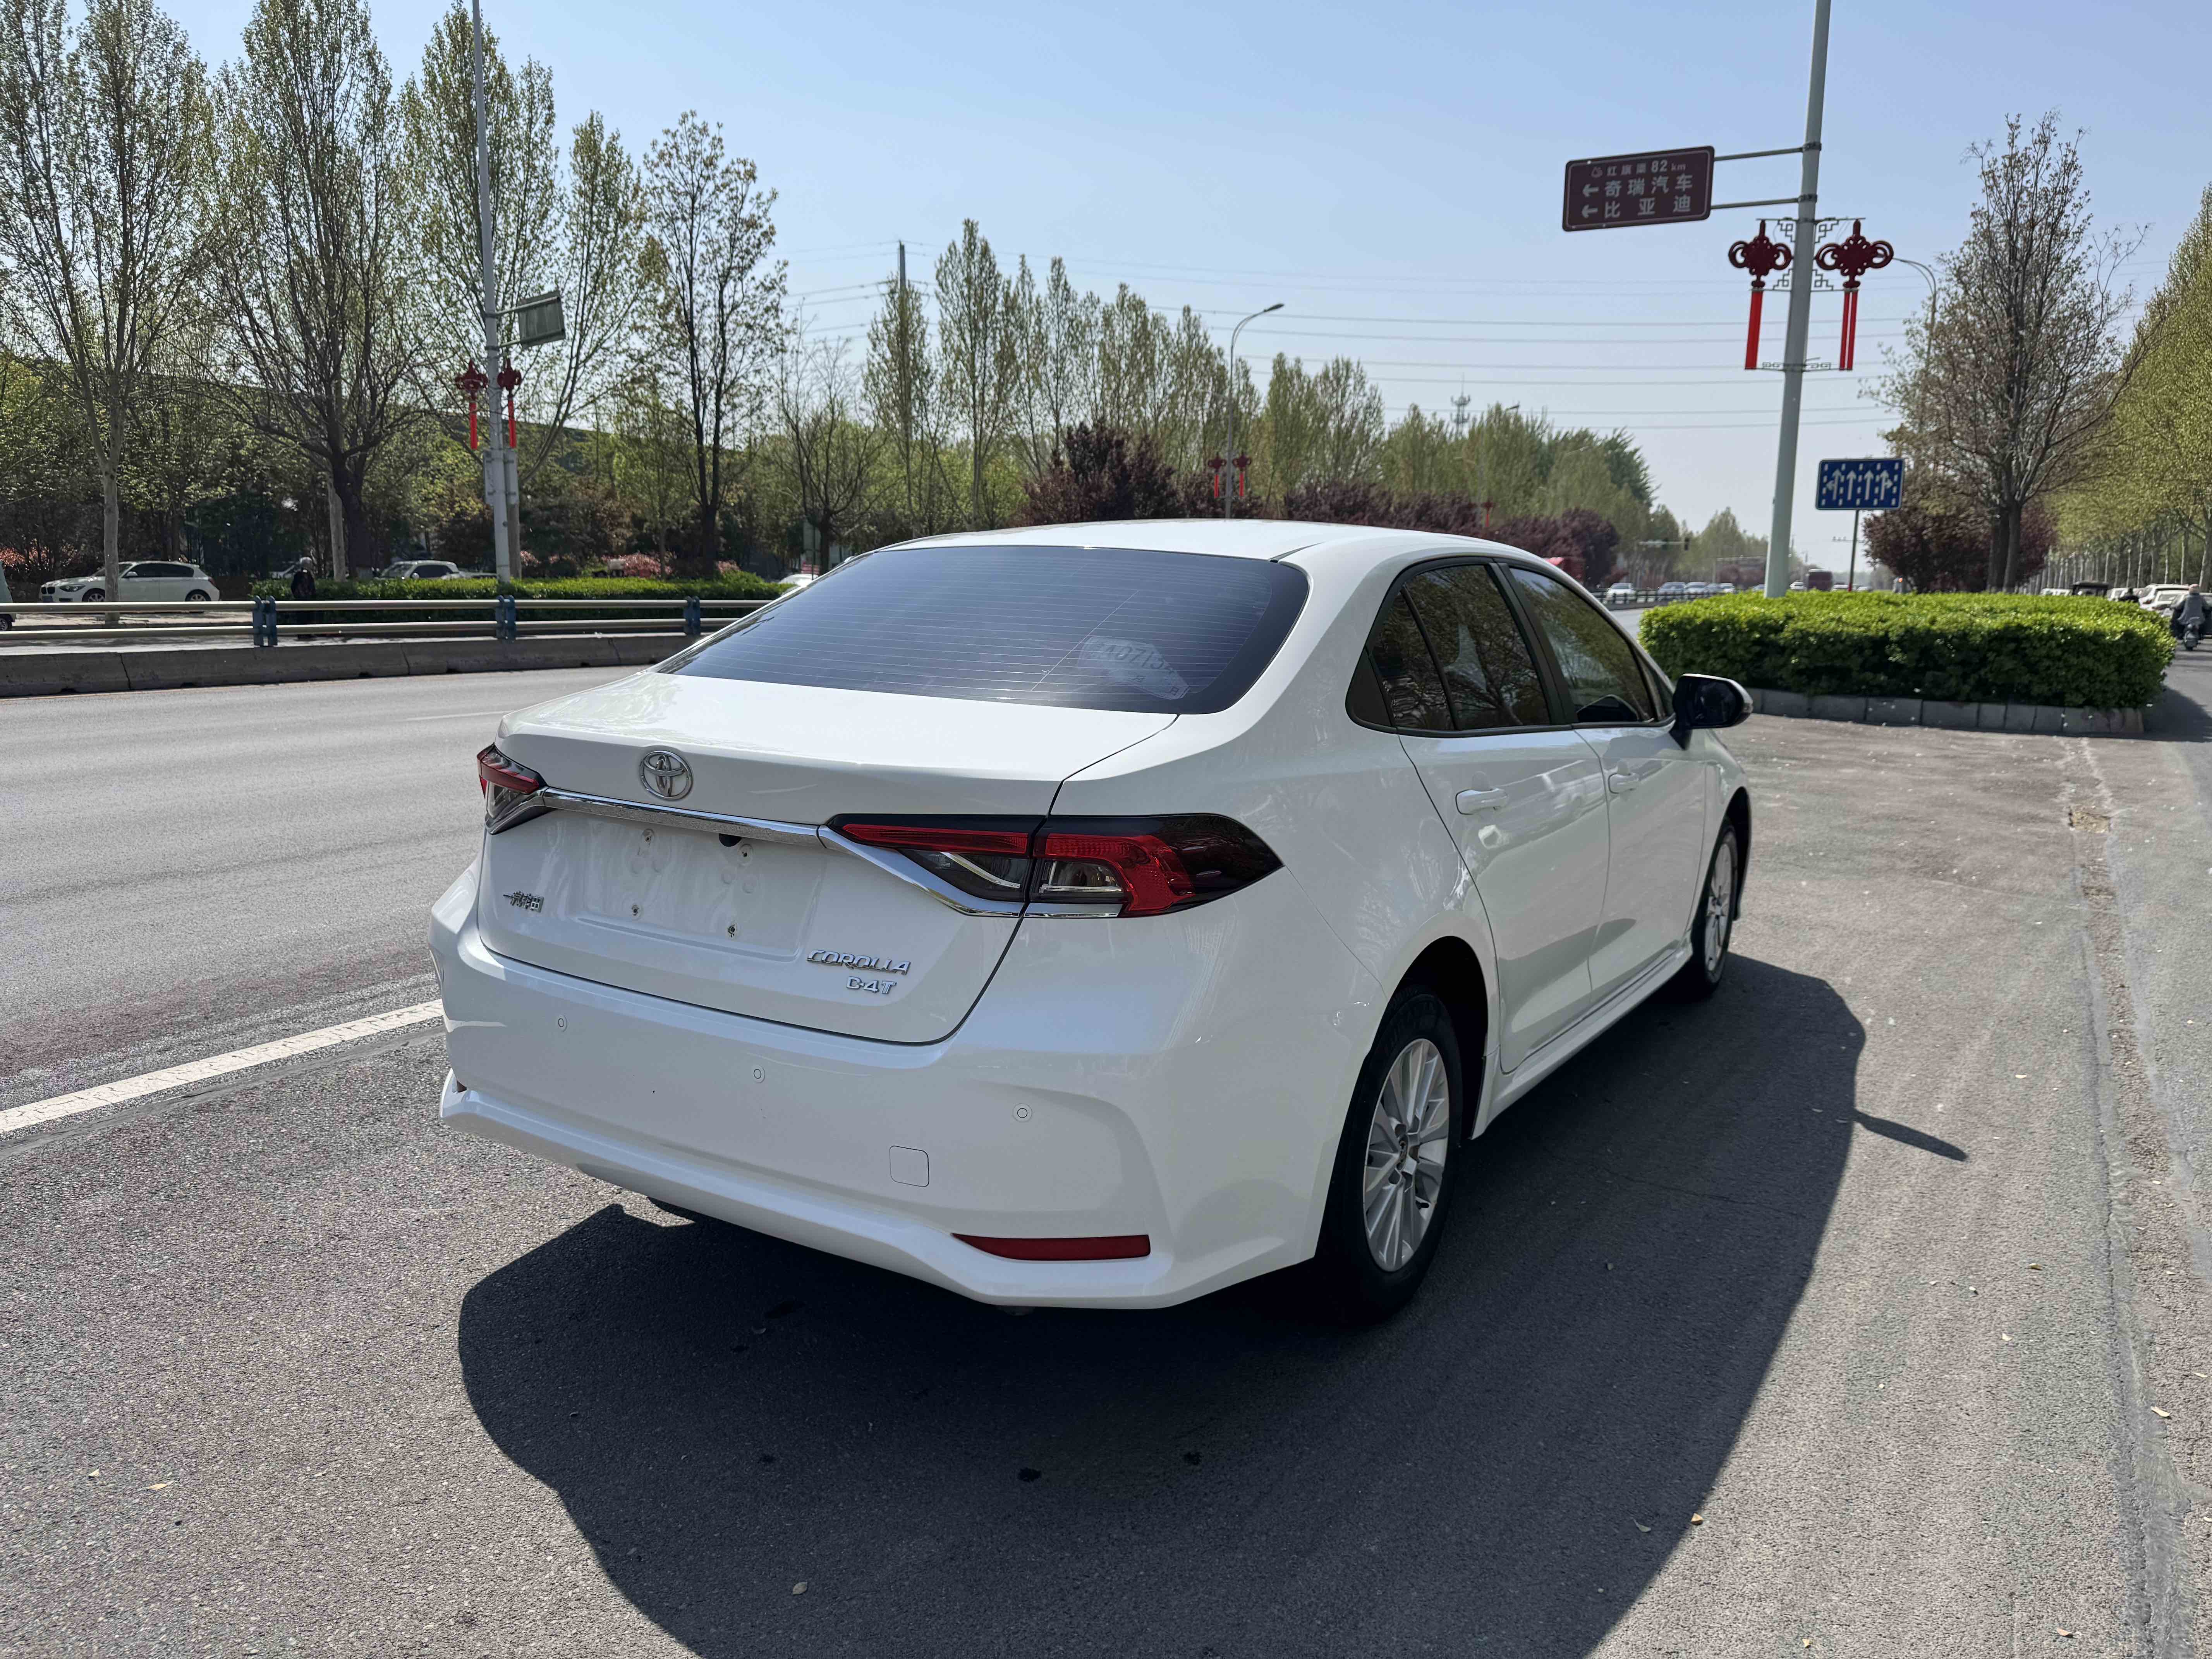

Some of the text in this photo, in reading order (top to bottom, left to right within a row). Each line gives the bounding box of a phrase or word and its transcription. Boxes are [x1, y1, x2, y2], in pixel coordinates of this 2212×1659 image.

[1651, 159, 1668, 173] 82
[1671, 163, 1686, 171] km
[1604, 173, 1693, 197] 奇瑞汽车
[1604, 195, 1691, 218] 比亚迪
[807, 950, 911, 975] COROLLA
